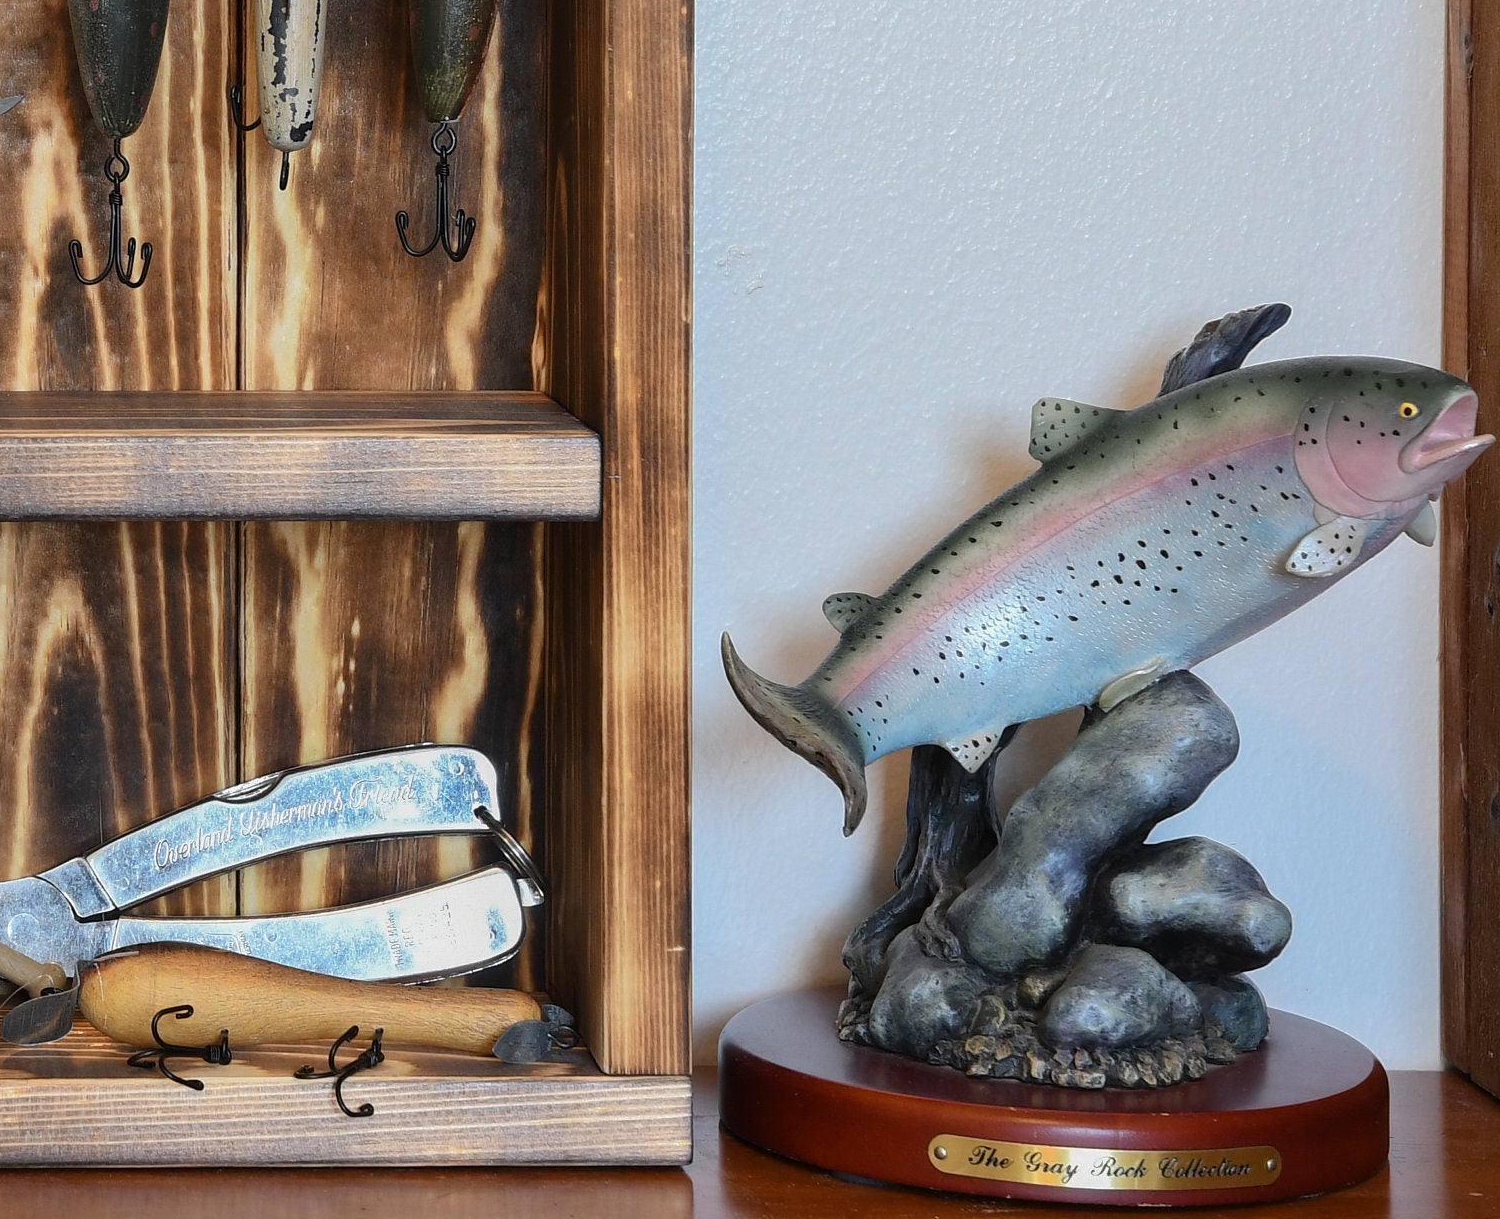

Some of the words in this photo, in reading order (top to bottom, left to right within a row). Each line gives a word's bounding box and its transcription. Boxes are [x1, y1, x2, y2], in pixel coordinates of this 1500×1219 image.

[154, 814, 234, 869] Overland
[240, 788, 344, 844] Fisherman's
[349, 774, 416, 809] Friend
[967, 1145, 1013, 1169] The
[1023, 1151, 1079, 1184] Gray
[1091, 1155, 1148, 1179] Rock
[1158, 1156, 1253, 1179] Collection
